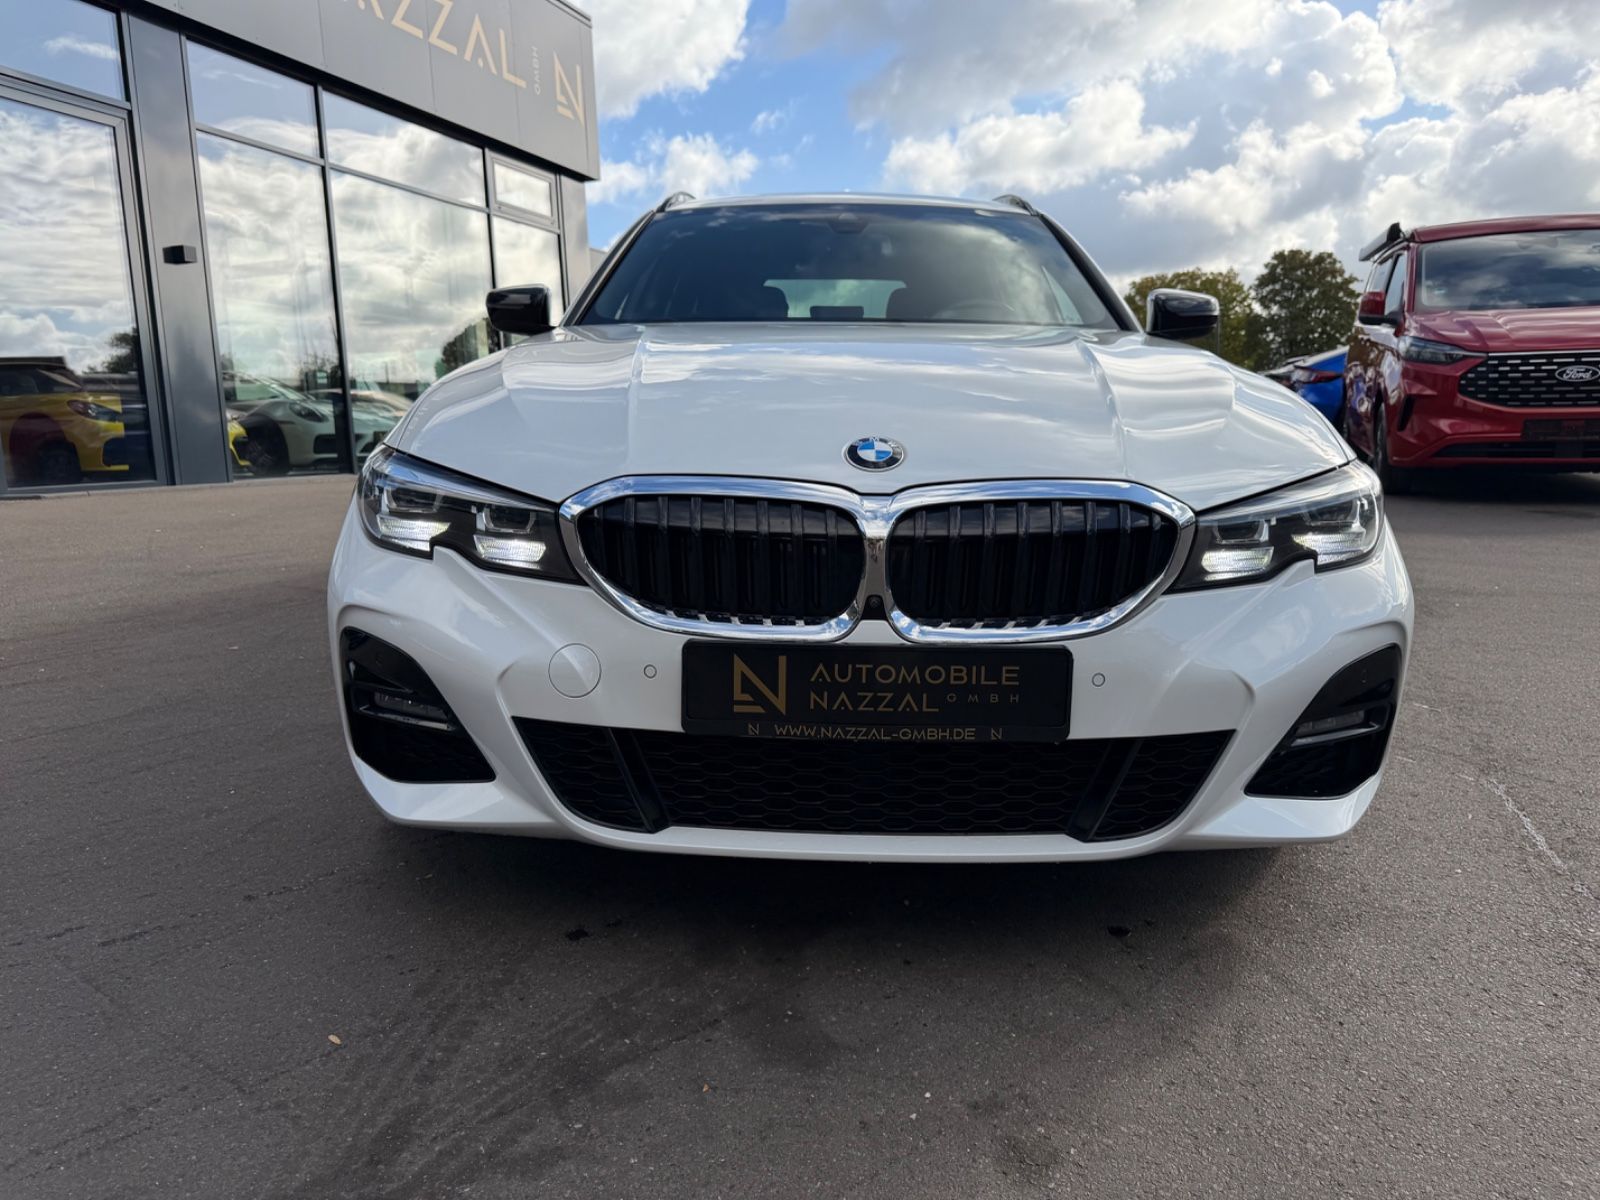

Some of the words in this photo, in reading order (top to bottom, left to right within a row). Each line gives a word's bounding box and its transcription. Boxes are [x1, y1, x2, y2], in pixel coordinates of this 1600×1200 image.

[1563, 367, 1593, 379] Ford
[810, 662, 1020, 686] AUTOMOBILE
[810, 691, 940, 712] NAZZAL
[946, 693, 1020, 704] GMBH
[774, 723, 976, 741] WWW.NAZZAL-GMBH.DE
